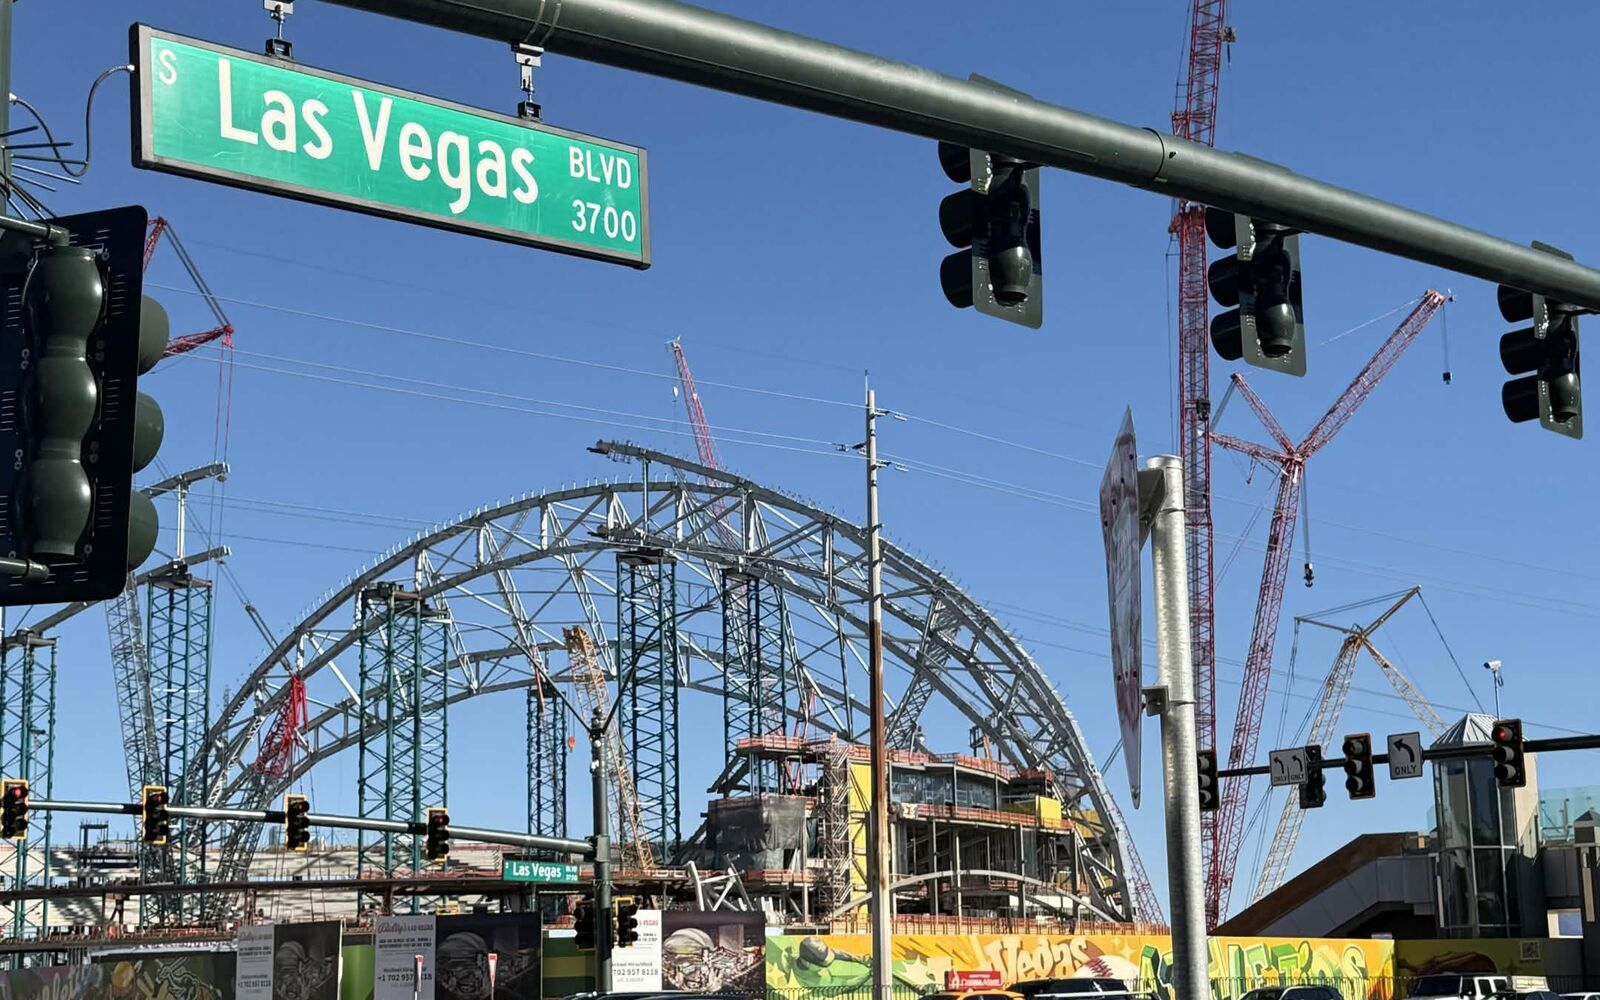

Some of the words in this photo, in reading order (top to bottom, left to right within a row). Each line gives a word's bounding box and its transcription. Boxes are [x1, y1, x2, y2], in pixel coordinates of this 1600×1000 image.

[158, 50, 177, 86] S
[218, 58, 333, 161] Las
[352, 90, 539, 214] Vegas
[569, 146, 632, 190] BLVD
[571, 200, 636, 243] 3700
[1290, 773, 1305, 781] ONLY
[1394, 764, 1417, 776] ONLY
[513, 862, 530, 876] Las
[532, 862, 562, 882] Vegas
